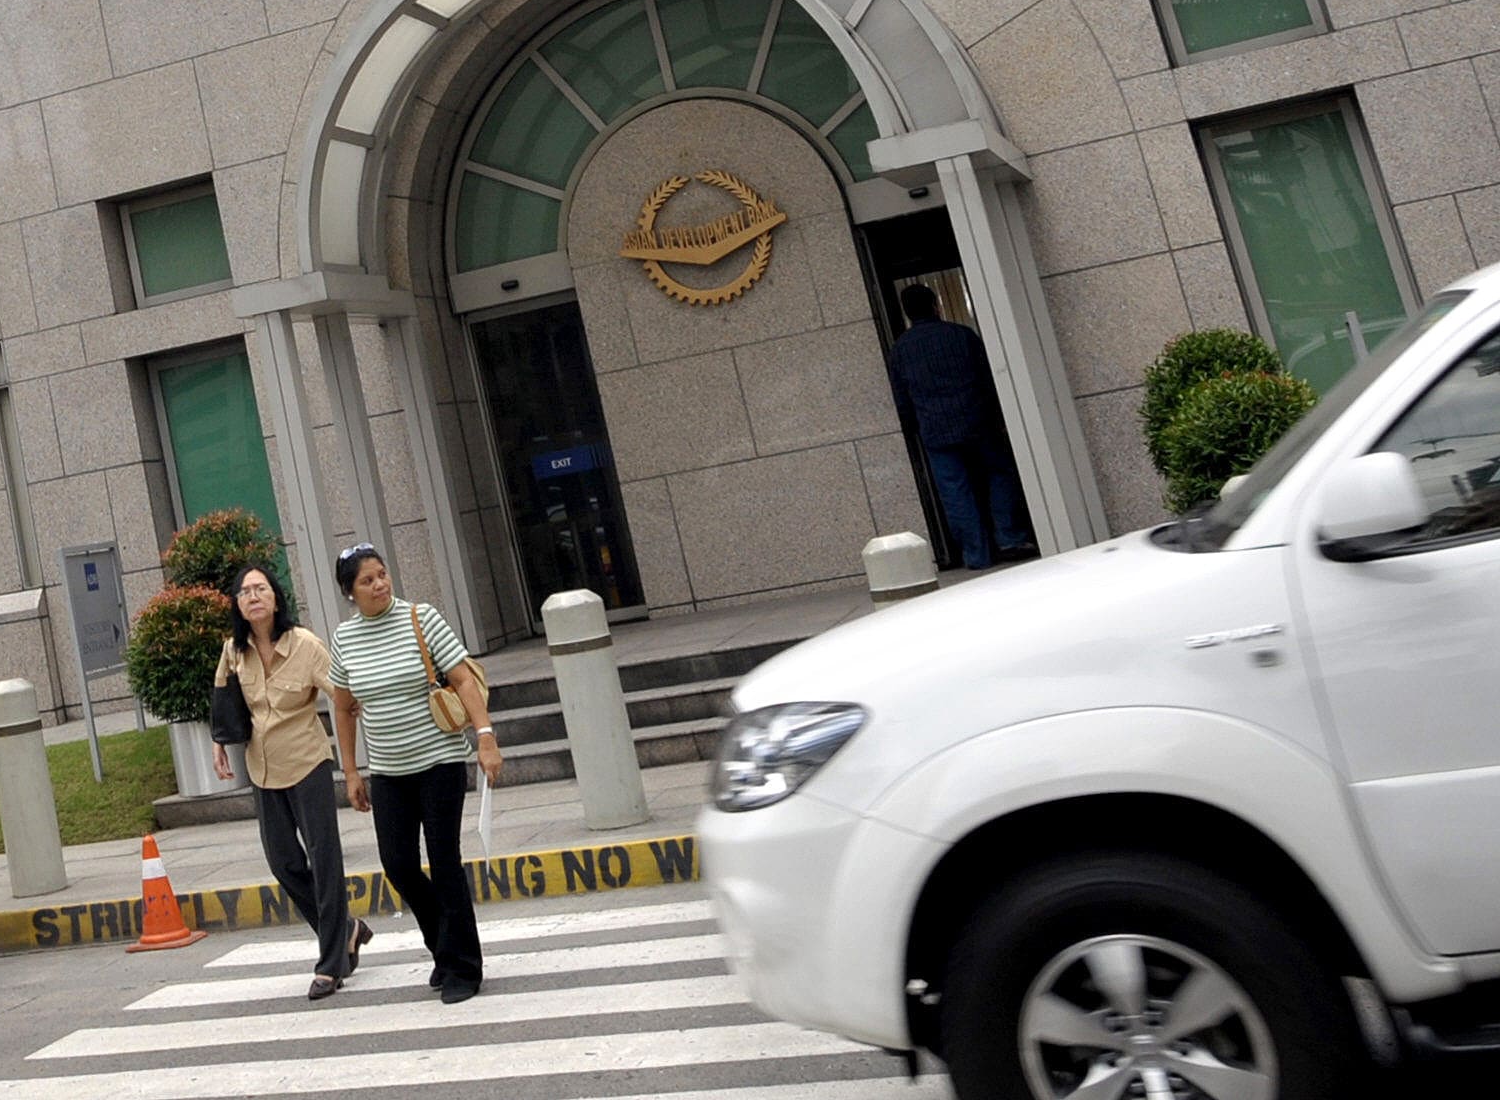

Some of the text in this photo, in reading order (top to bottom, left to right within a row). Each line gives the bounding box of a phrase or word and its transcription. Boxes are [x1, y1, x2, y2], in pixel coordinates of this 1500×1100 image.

[623, 198, 779, 251] ASIAN DEVELOPMENT BANK
[551, 457, 571, 469] EXIT
[260, 884, 305, 925] N
[344, 855, 546, 915] PAING
[562, 846, 631, 892] NO
